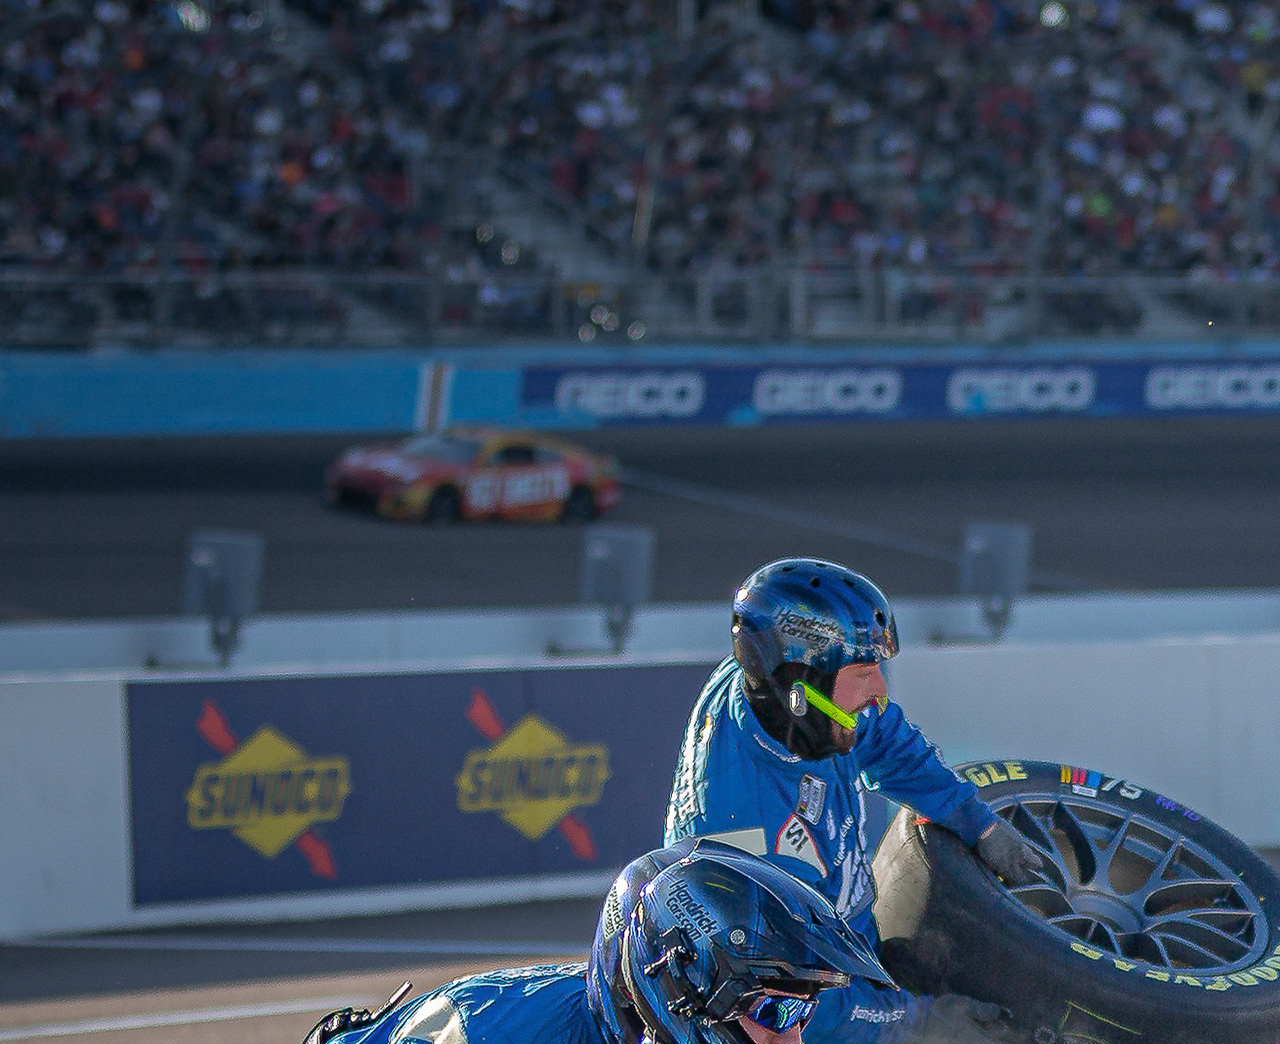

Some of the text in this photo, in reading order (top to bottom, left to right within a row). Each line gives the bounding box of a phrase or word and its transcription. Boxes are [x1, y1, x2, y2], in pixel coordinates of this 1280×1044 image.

[753, 367, 902, 413] GEICO
[947, 366, 1096, 412] GEICO
[777, 608, 840, 636] Hendrick
[778, 623, 830, 646] Cars.com
[198, 764, 344, 822] SUNOCO
[463, 747, 605, 808] SUNOCO
[963, 762, 1027, 787] GLE
[665, 897, 701, 942] Cars.com
[668, 879, 718, 935] Hendrick
